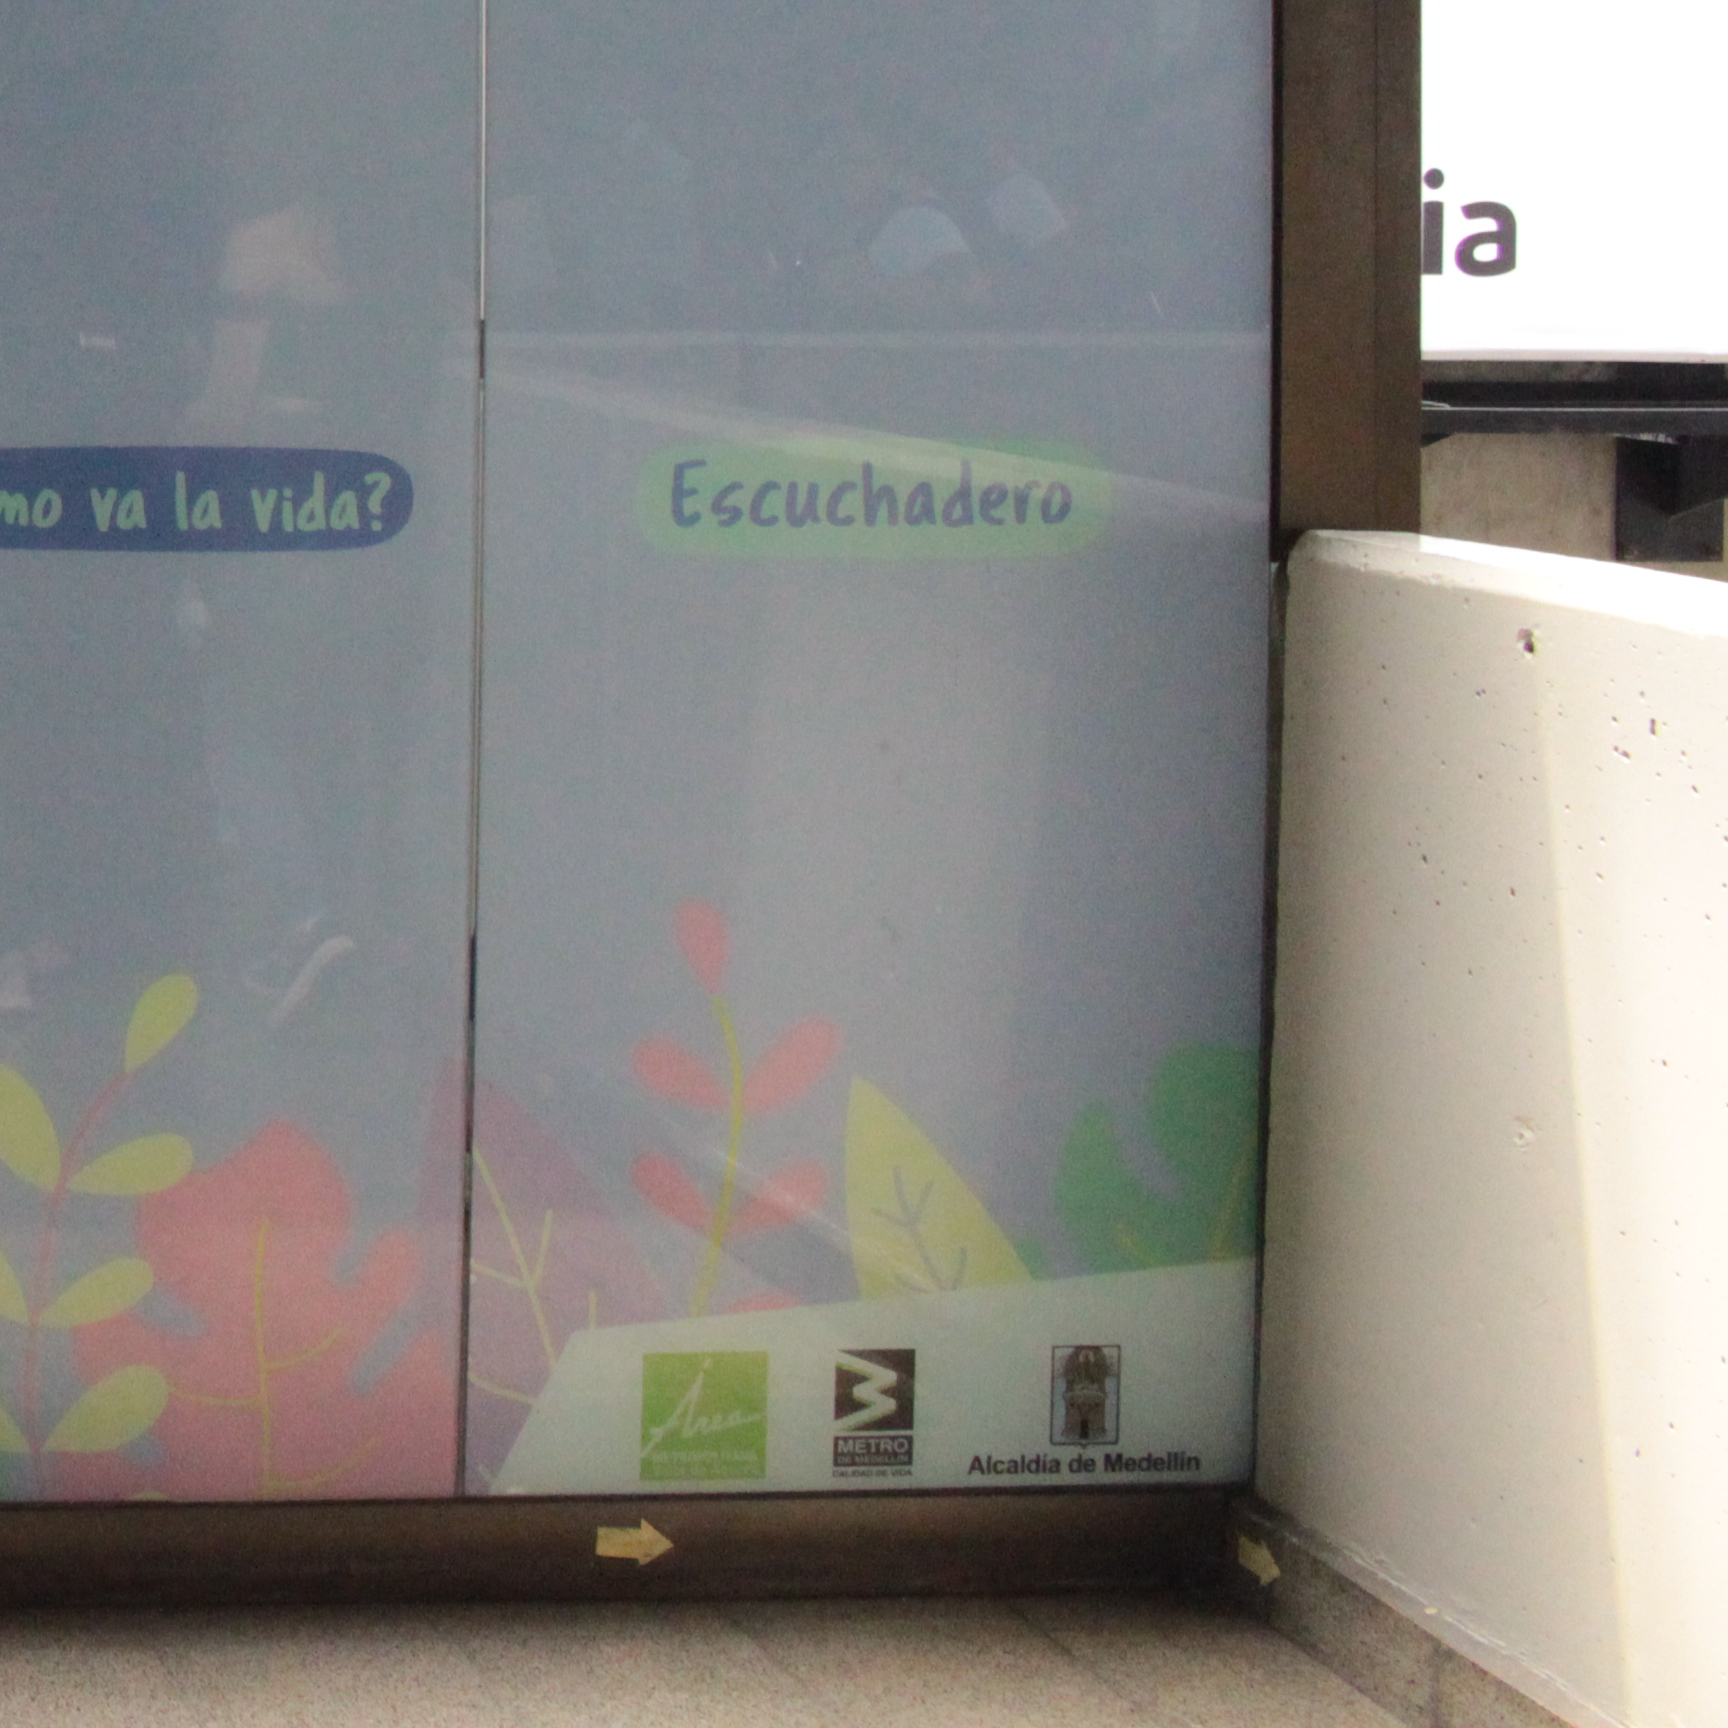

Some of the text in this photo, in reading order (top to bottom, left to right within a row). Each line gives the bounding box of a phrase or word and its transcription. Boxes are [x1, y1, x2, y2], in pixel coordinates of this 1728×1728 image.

[90, 486, 147, 532] va
[174, 471, 223, 532] la
[250, 471, 392, 533] vida?
[670, 458, 1073, 528] Escuchadero
[837, 1437, 909, 1453] METRO
[967, 1452, 1061, 1475] Alcaldía
[1068, 1453, 1097, 1473] de
